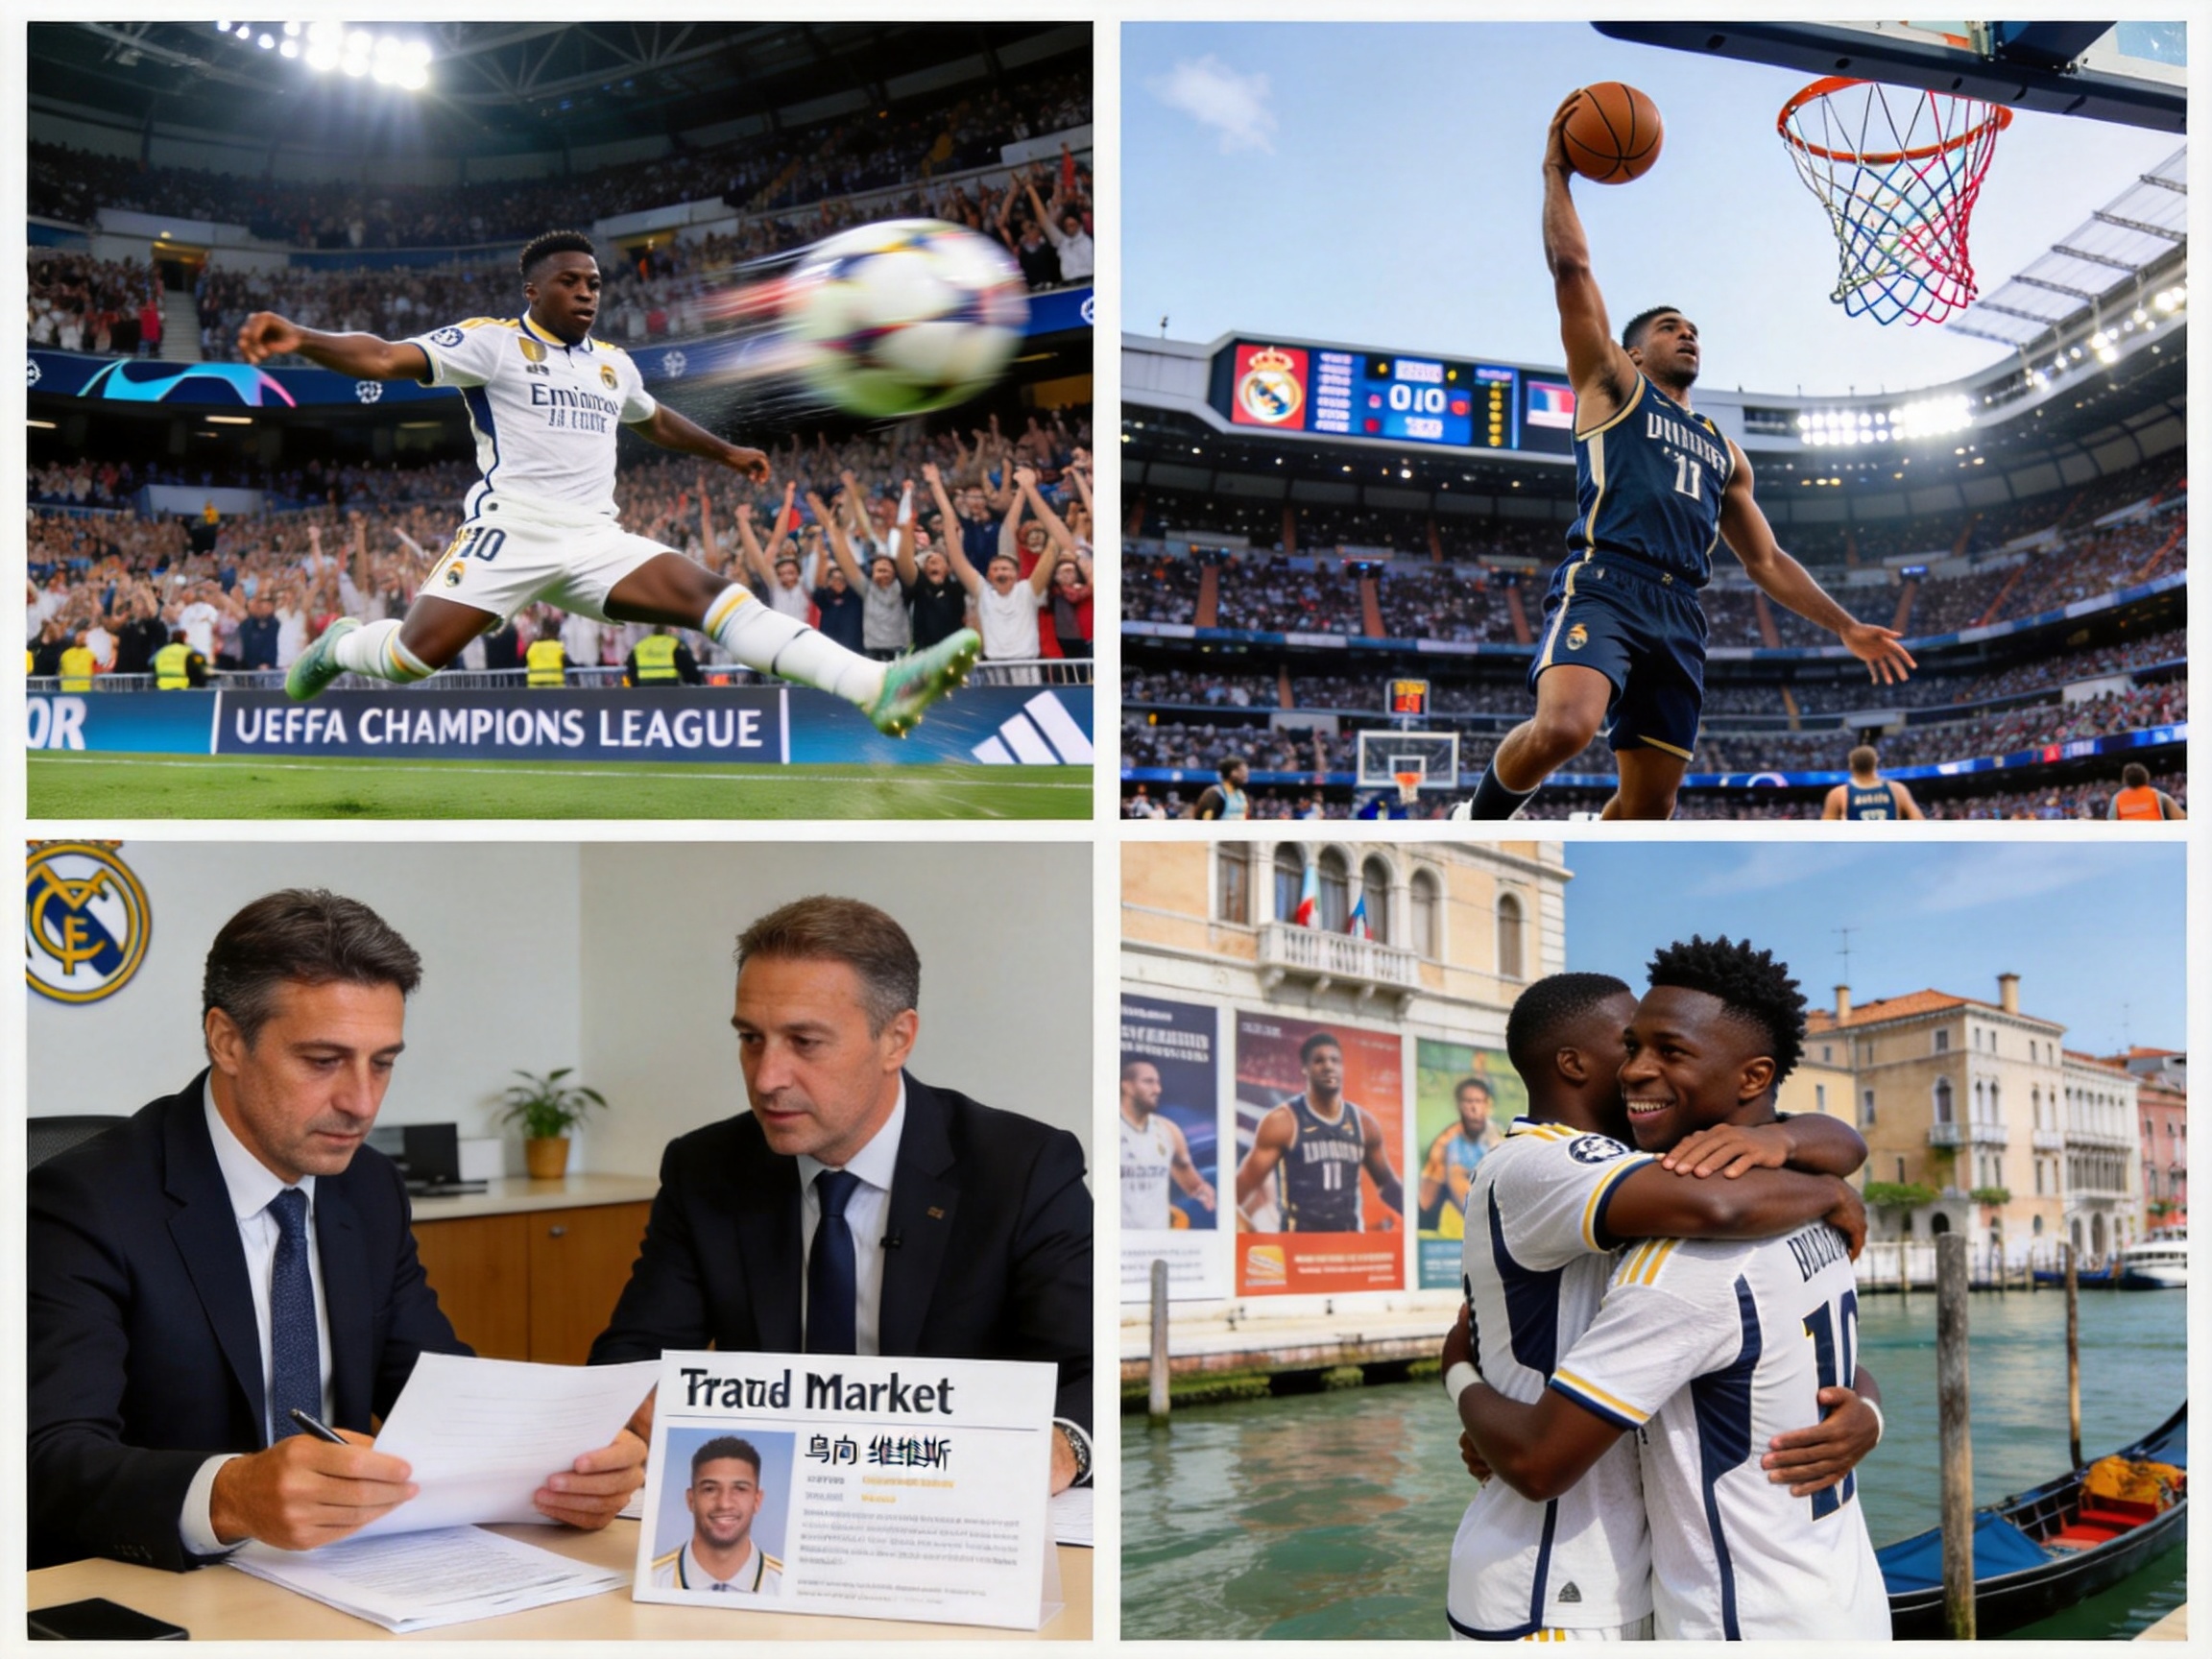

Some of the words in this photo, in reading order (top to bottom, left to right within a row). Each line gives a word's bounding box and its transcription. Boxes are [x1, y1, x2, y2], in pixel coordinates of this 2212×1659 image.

[27, 696, 85, 750] OR
[235, 708, 348, 744] UEFFA
[358, 708, 586, 747] CHAMPIONS
[599, 709, 763, 748] LEAGUE
[805, 1372, 955, 1415] Market
